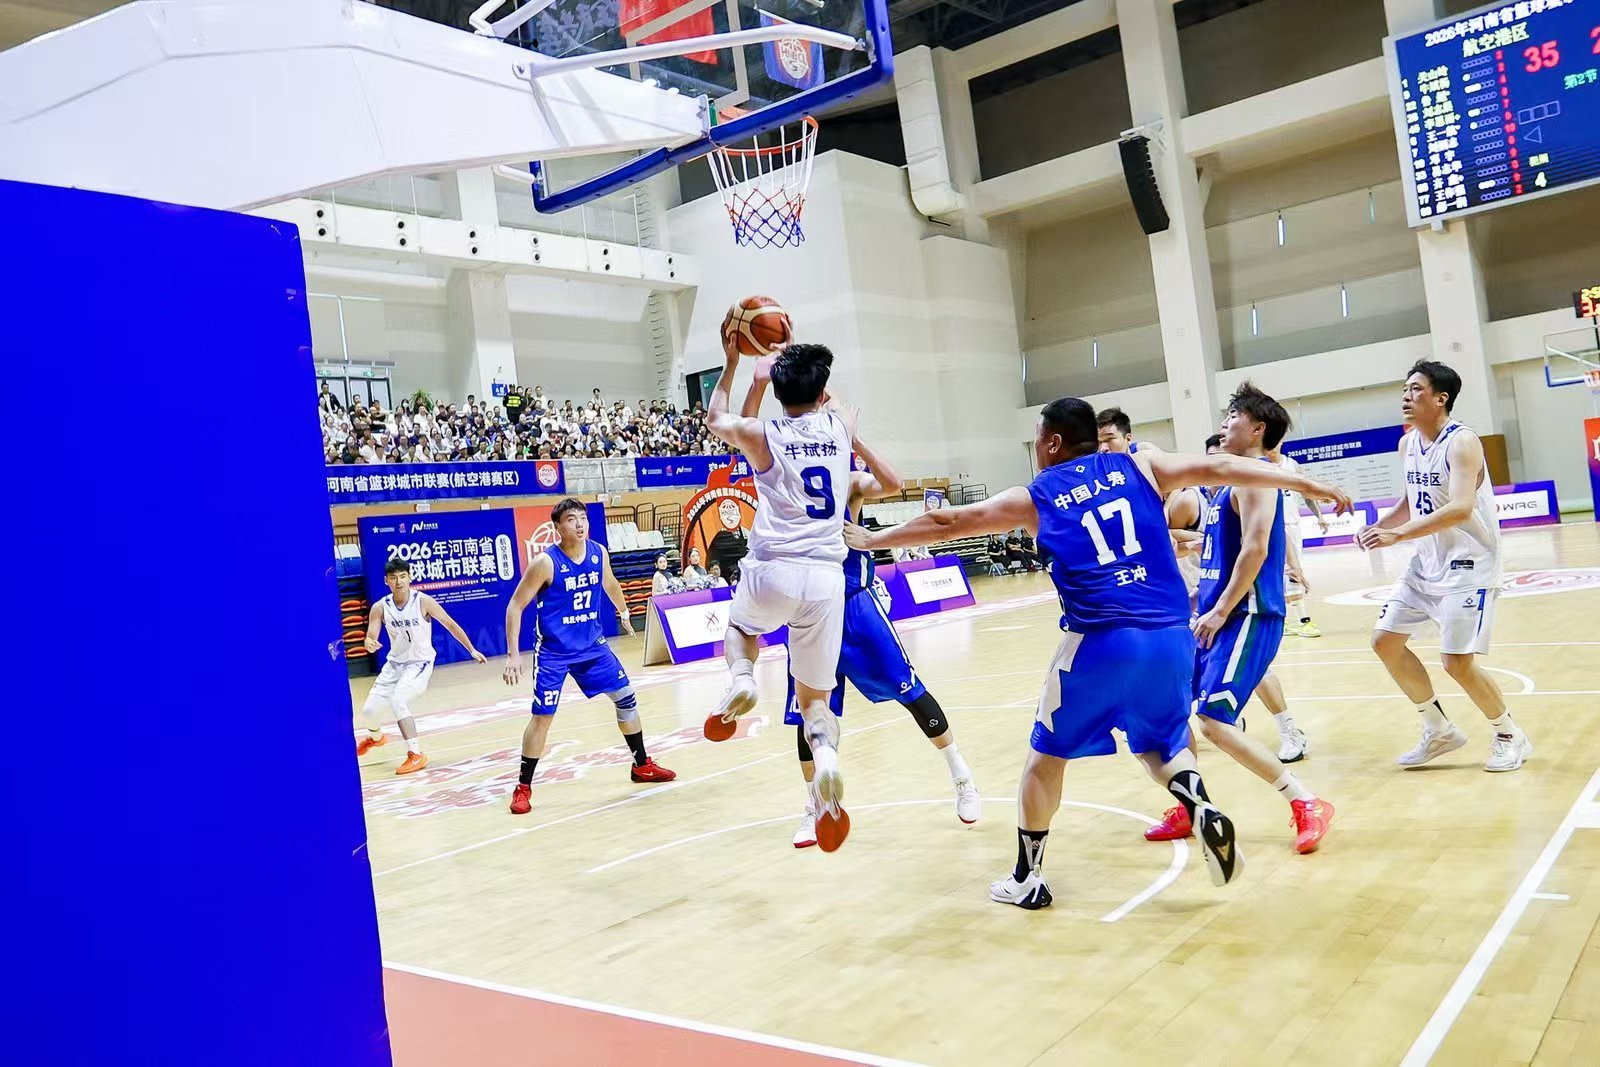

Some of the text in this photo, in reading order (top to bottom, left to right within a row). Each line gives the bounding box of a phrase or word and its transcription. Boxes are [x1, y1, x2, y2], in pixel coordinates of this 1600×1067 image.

[1463, 22, 1530, 57] 航空港区
[1523, 41, 1560, 72] 35
[1564, 69, 1598, 89] 第2节
[1535, 172, 1547, 187] 4
[784, 441, 837, 460] 牛斌扬
[800, 465, 836, 520] 9
[1053, 470, 1127, 510] 中国人寿
[1080, 497, 1143, 566] 17
[386, 536, 494, 563] 2026年河南省
[564, 570, 600, 592] 商丘市
[1114, 564, 1147, 586] 王冲
[573, 590, 592, 611] 27
[406, 630, 411, 643] 1
[544, 690, 560, 706] 27
